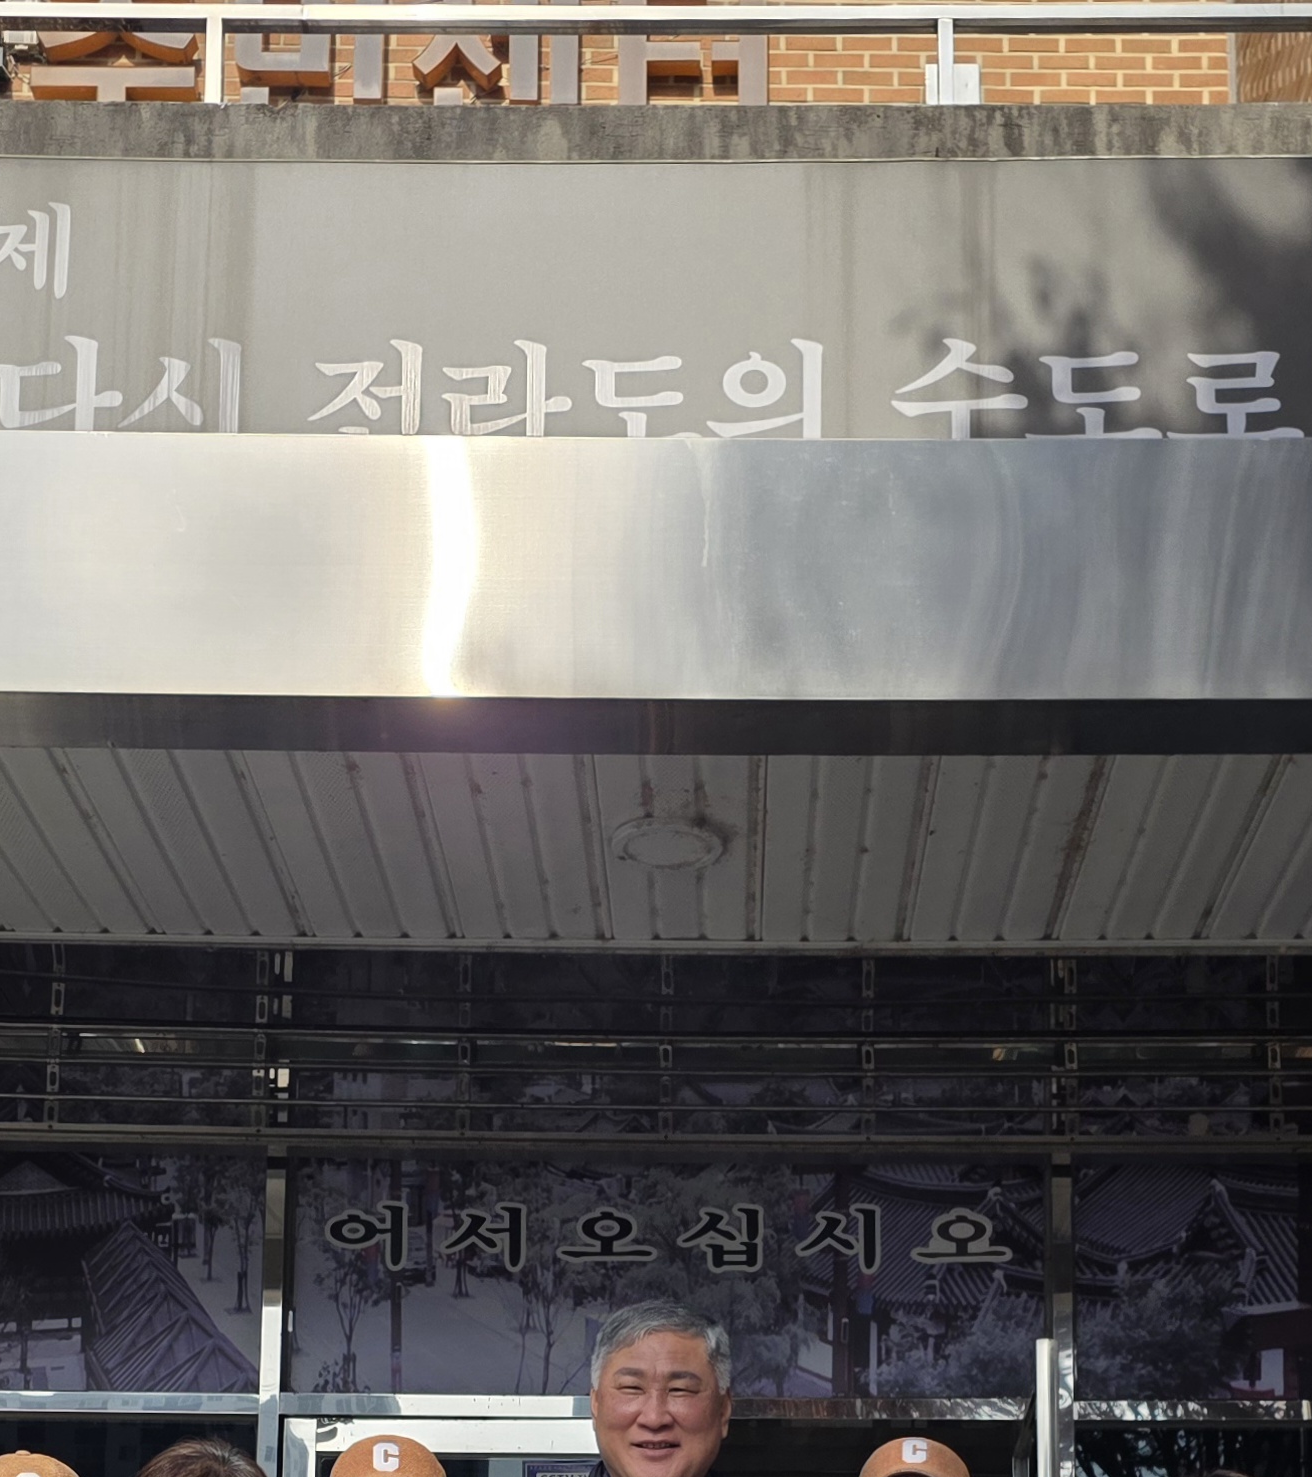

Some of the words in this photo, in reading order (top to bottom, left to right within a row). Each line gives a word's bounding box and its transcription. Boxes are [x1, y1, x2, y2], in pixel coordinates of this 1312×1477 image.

[308, 338, 825, 439] 전라도의
[325, 1201, 1013, 1273] 어서오십시오
[372, 1442, 400, 1473] C
[901, 1438, 928, 1464] C
